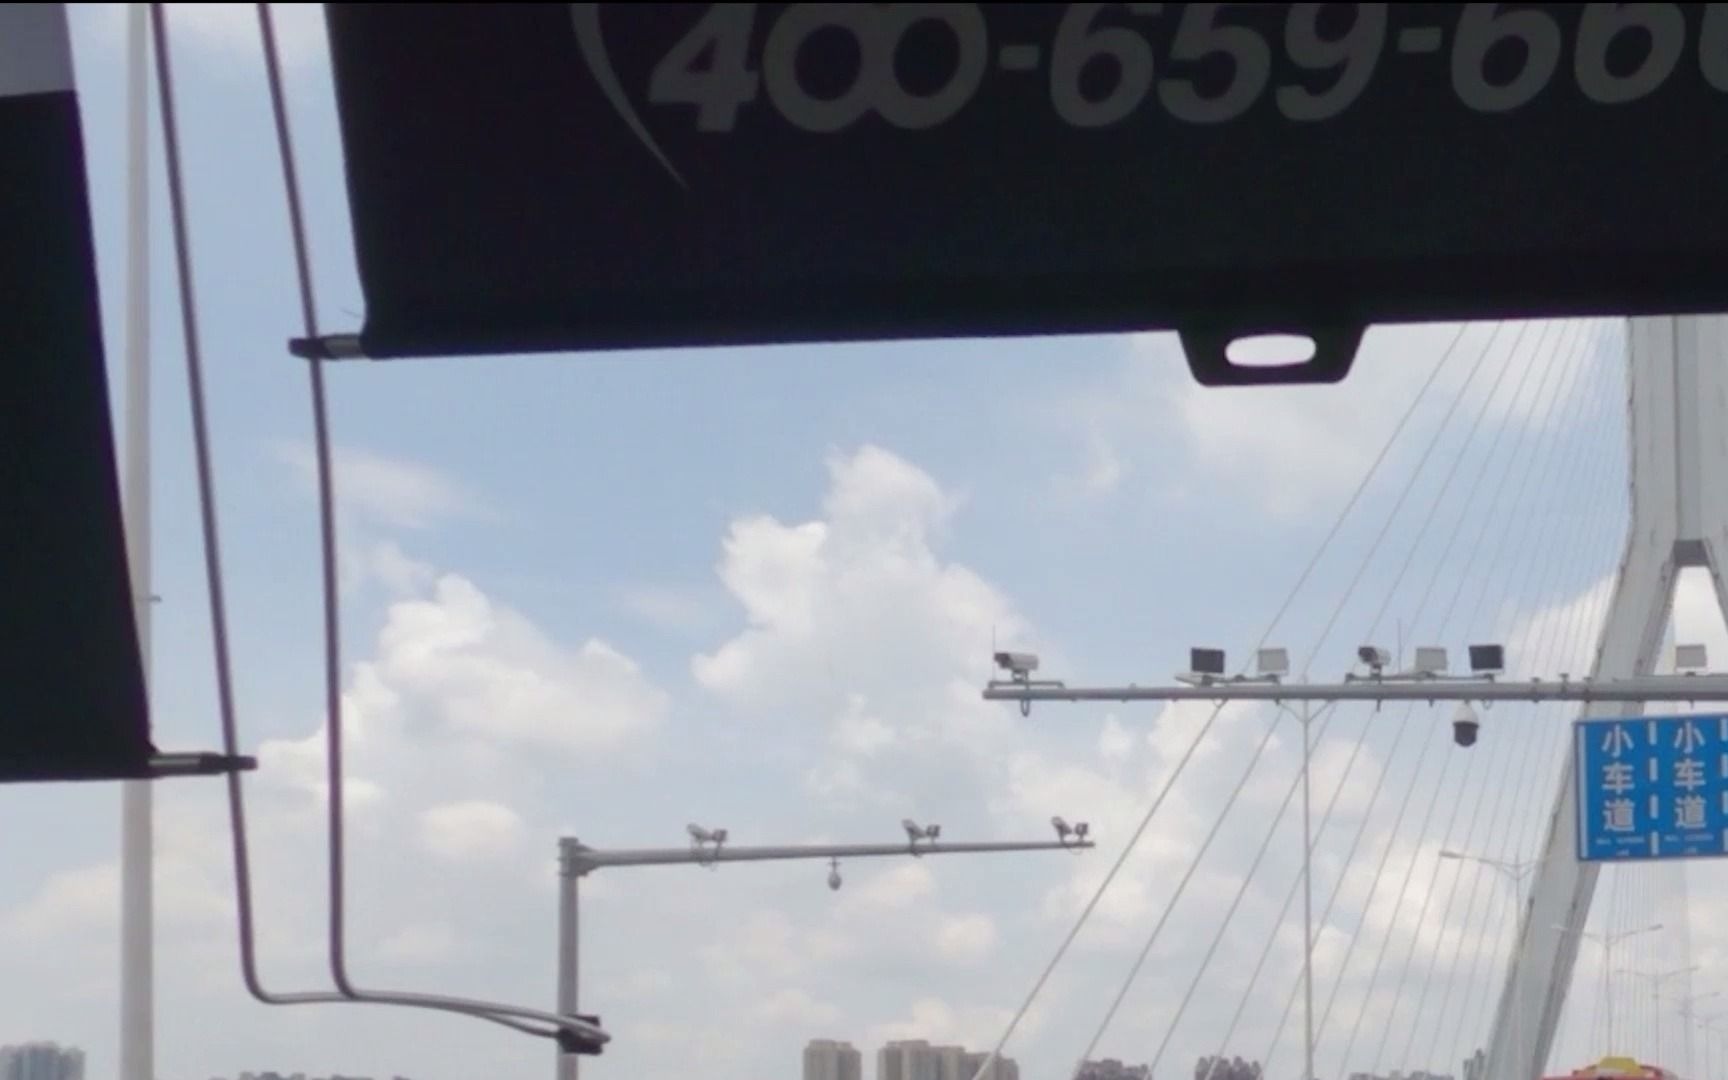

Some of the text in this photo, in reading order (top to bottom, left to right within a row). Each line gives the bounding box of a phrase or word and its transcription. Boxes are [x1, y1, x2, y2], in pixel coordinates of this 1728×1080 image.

[1602, 724, 1635, 832] 小车道
[1674, 720, 1706, 829] 小车道
